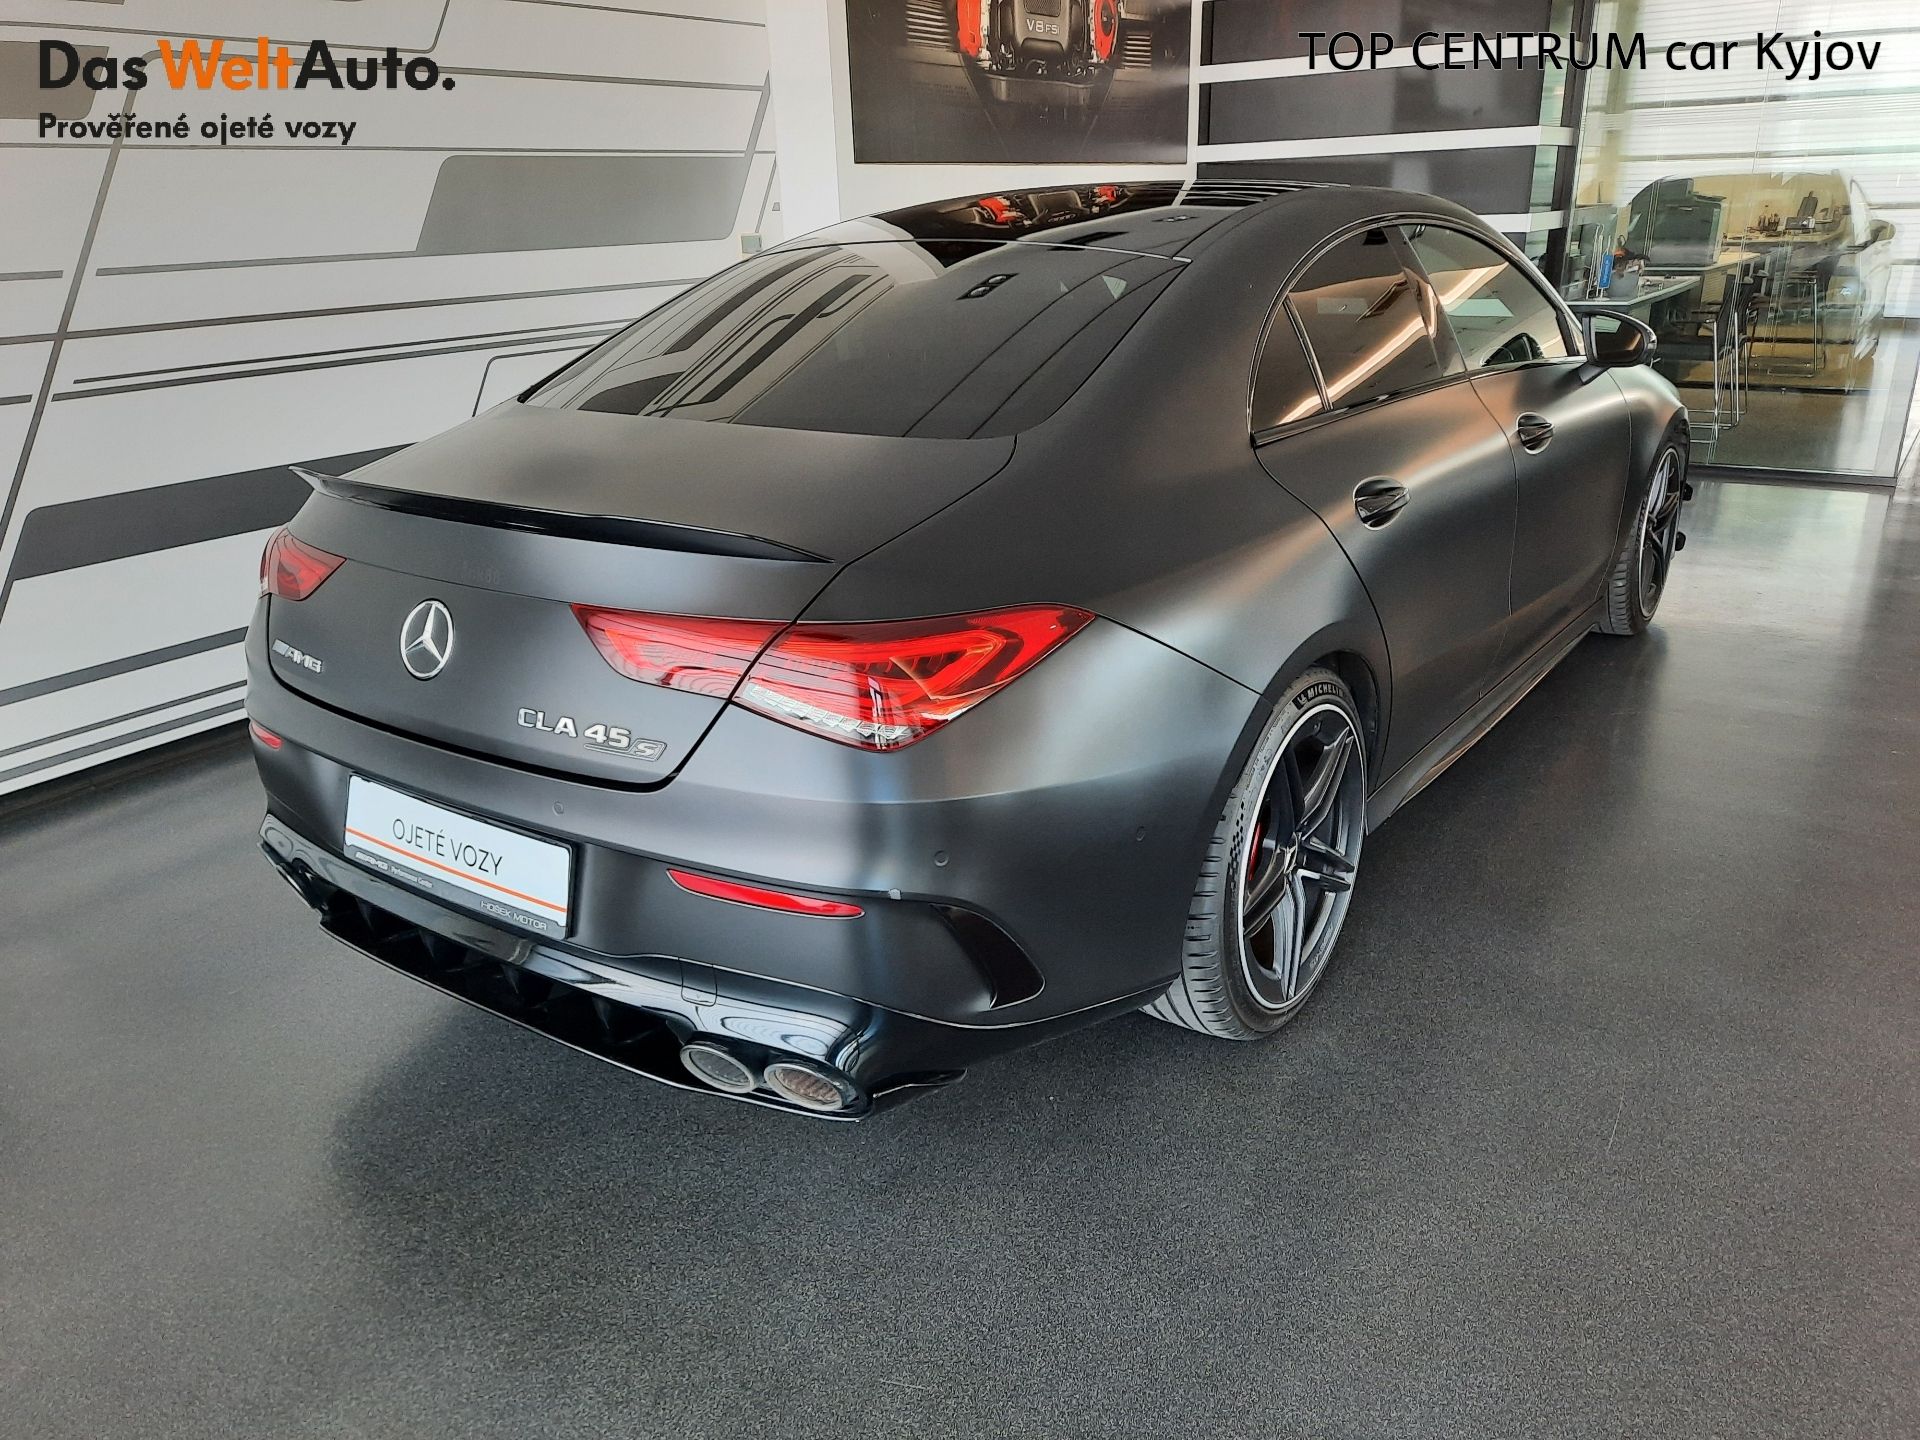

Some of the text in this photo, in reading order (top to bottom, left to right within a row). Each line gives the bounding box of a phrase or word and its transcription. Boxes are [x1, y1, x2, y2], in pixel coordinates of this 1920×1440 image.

[1026, 18, 1044, 33] V8
[518, 707, 578, 738] CLA
[583, 724, 632, 749] 45
[392, 818, 503, 876] OJETÉ VOZY
